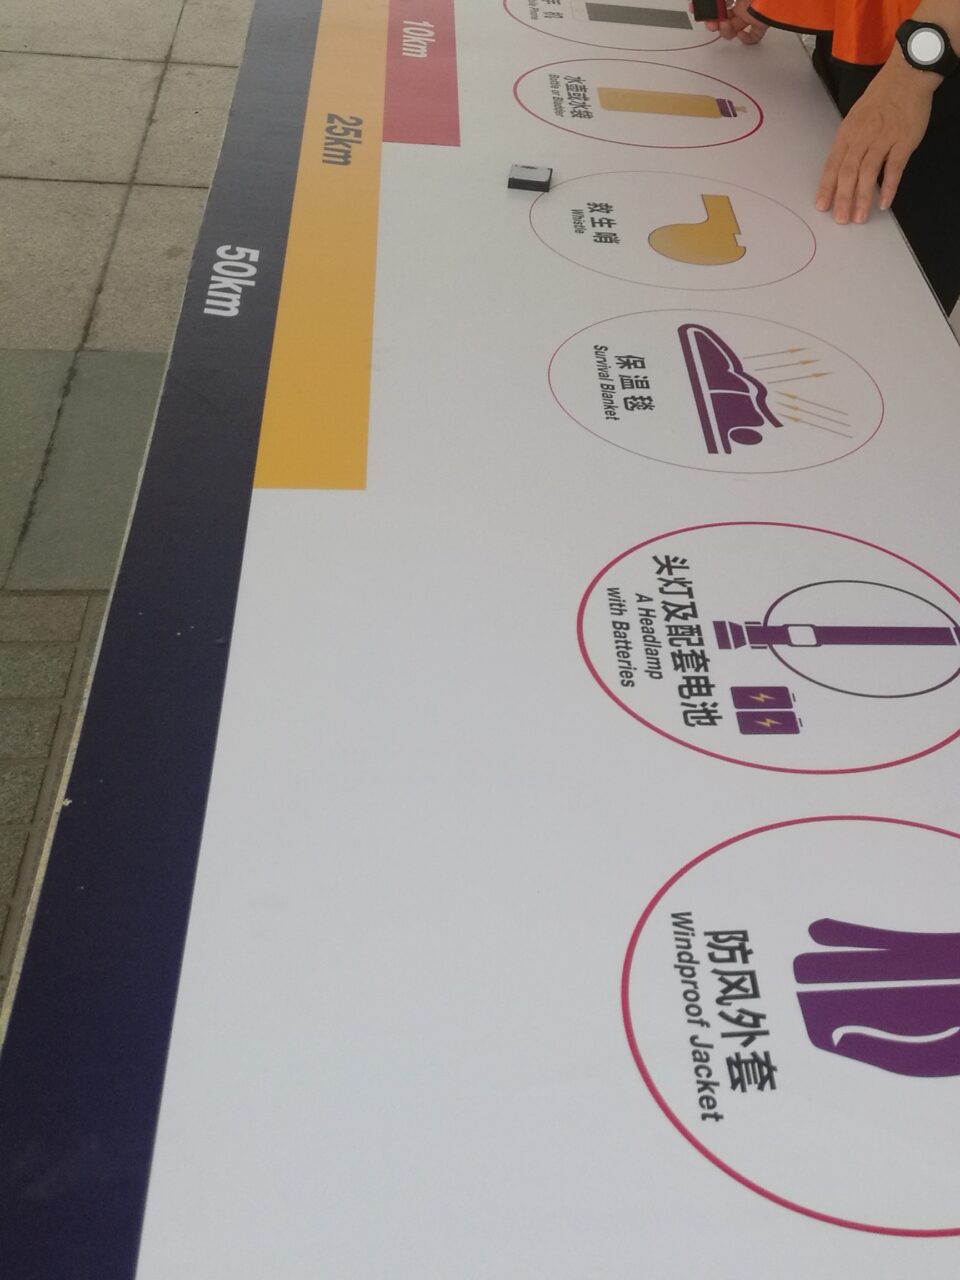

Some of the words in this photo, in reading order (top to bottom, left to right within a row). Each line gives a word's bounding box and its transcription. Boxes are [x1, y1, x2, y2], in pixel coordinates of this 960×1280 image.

[402, 20, 435, 58] 10km
[549, 74, 560, 89] Bottle
[563, 75, 594, 119] 水壶或水袋
[553, 96, 564, 117] Bladder
[322, 113, 363, 166] 25km
[571, 208, 585, 234] Whistle
[587, 202, 621, 244] 救生哨
[203, 244, 260, 318] 50km
[593, 345, 614, 381] Survival
[614, 355, 655, 411] 保温毯
[600, 382, 620, 421] Blanket
[607, 587, 627, 616] with
[635, 592, 654, 603] A
[612, 620, 637, 688] Batteries
[637, 607, 664, 680] Headlamp
[652, 555, 723, 727] 头灯及配套电池
[671, 912, 711, 1029] Windproof
[704, 930, 778, 1093] 防风外套
[689, 1034, 724, 1122] Jacket
